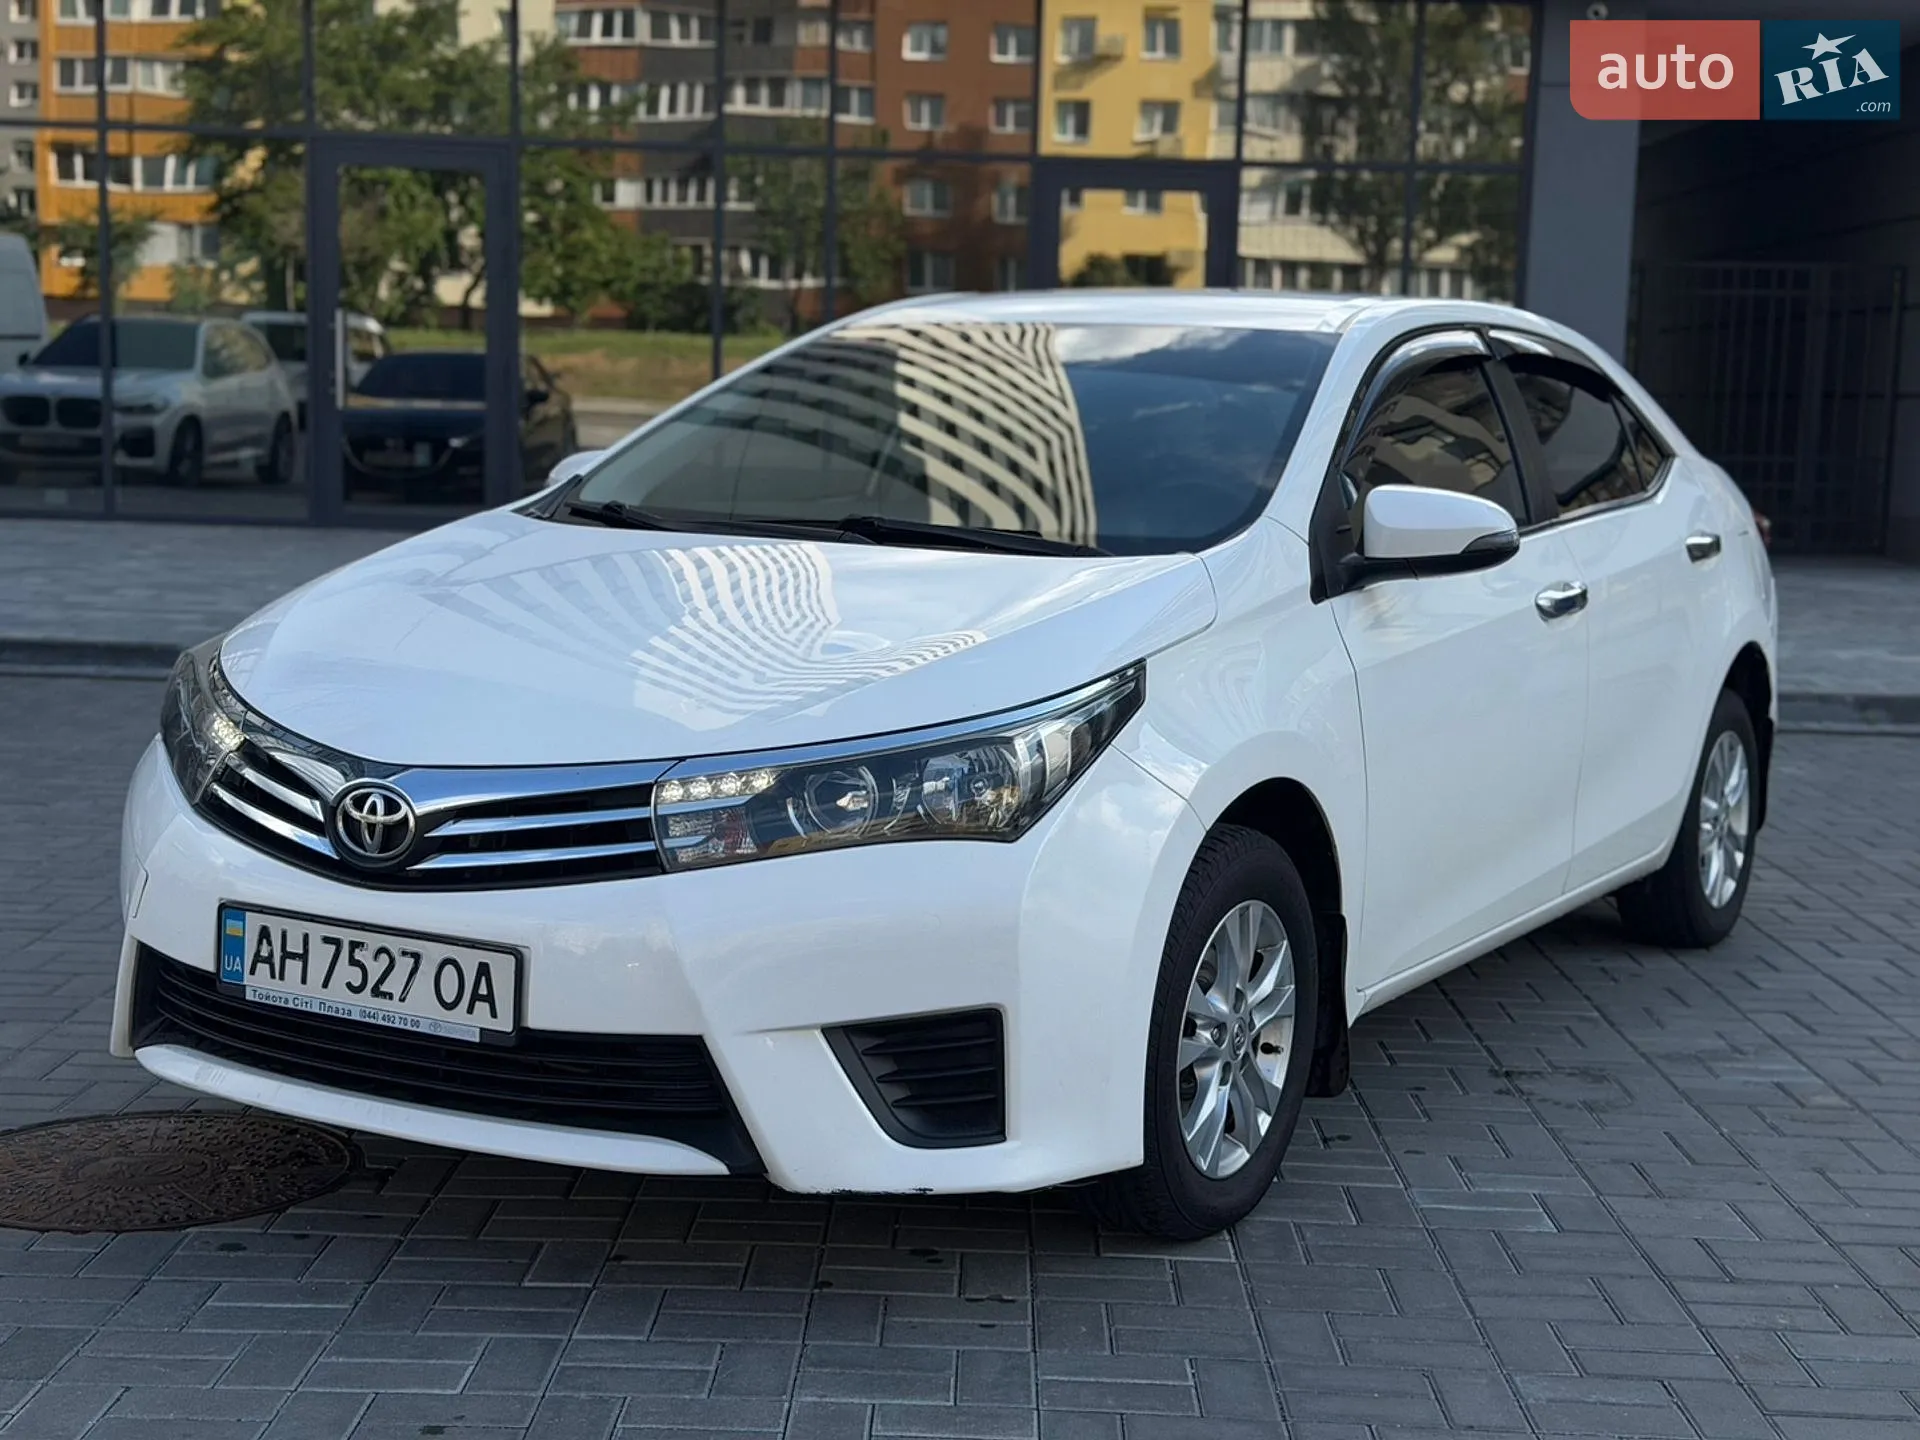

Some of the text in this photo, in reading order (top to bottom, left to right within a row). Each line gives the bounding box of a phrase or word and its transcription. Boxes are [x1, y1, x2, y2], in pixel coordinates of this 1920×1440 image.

[225, 954, 242, 972] UA
[249, 924, 498, 1019] AH 7527 OA
[252, 989, 290, 1005] Тойота
[318, 1001, 352, 1017] Плаза
[359, 1008, 380, 1022] (044)
[381, 1013, 396, 1025] 492
[398, 1015, 408, 1026] 70
[410, 1019, 421, 1029] 00
